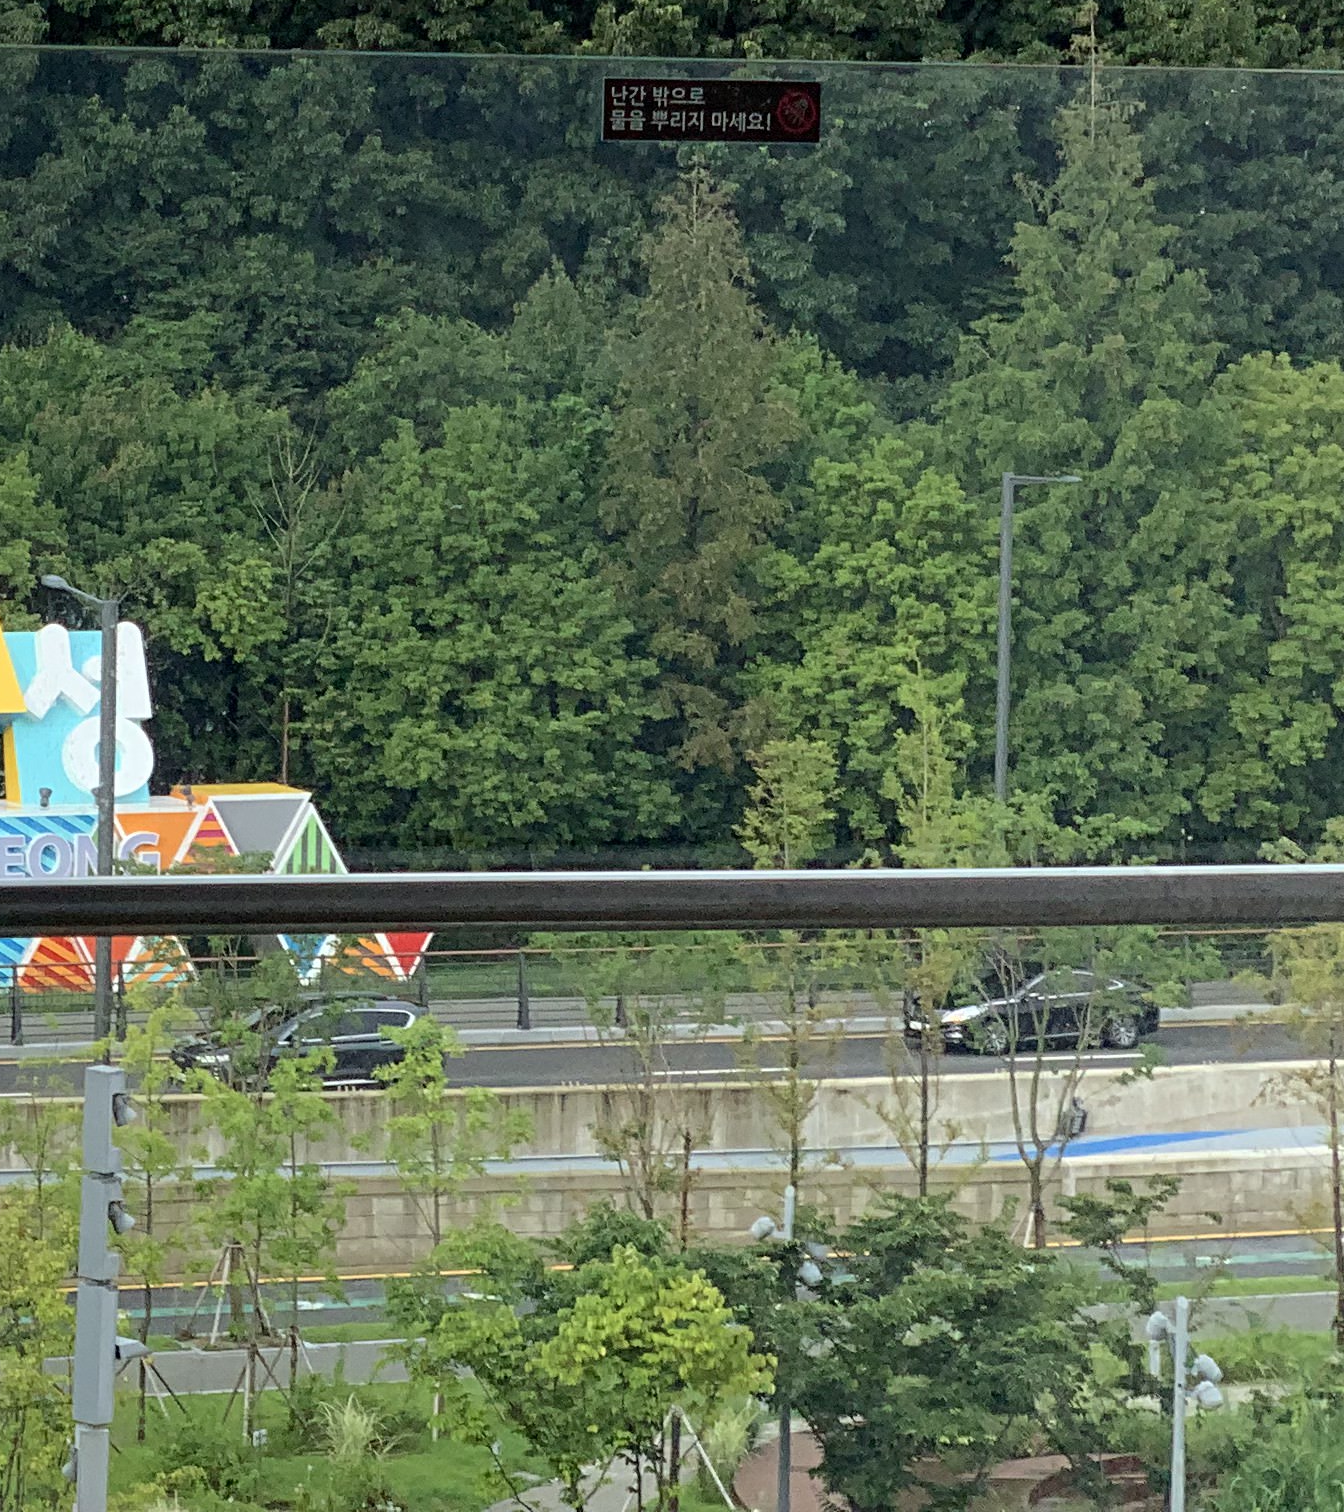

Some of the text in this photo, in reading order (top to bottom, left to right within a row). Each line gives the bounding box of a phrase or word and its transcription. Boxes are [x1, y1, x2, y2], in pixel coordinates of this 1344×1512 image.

[611, 85, 705, 107] 난간 밖으로
[610, 109, 771, 133] 물을 뿌리지 마세요!
